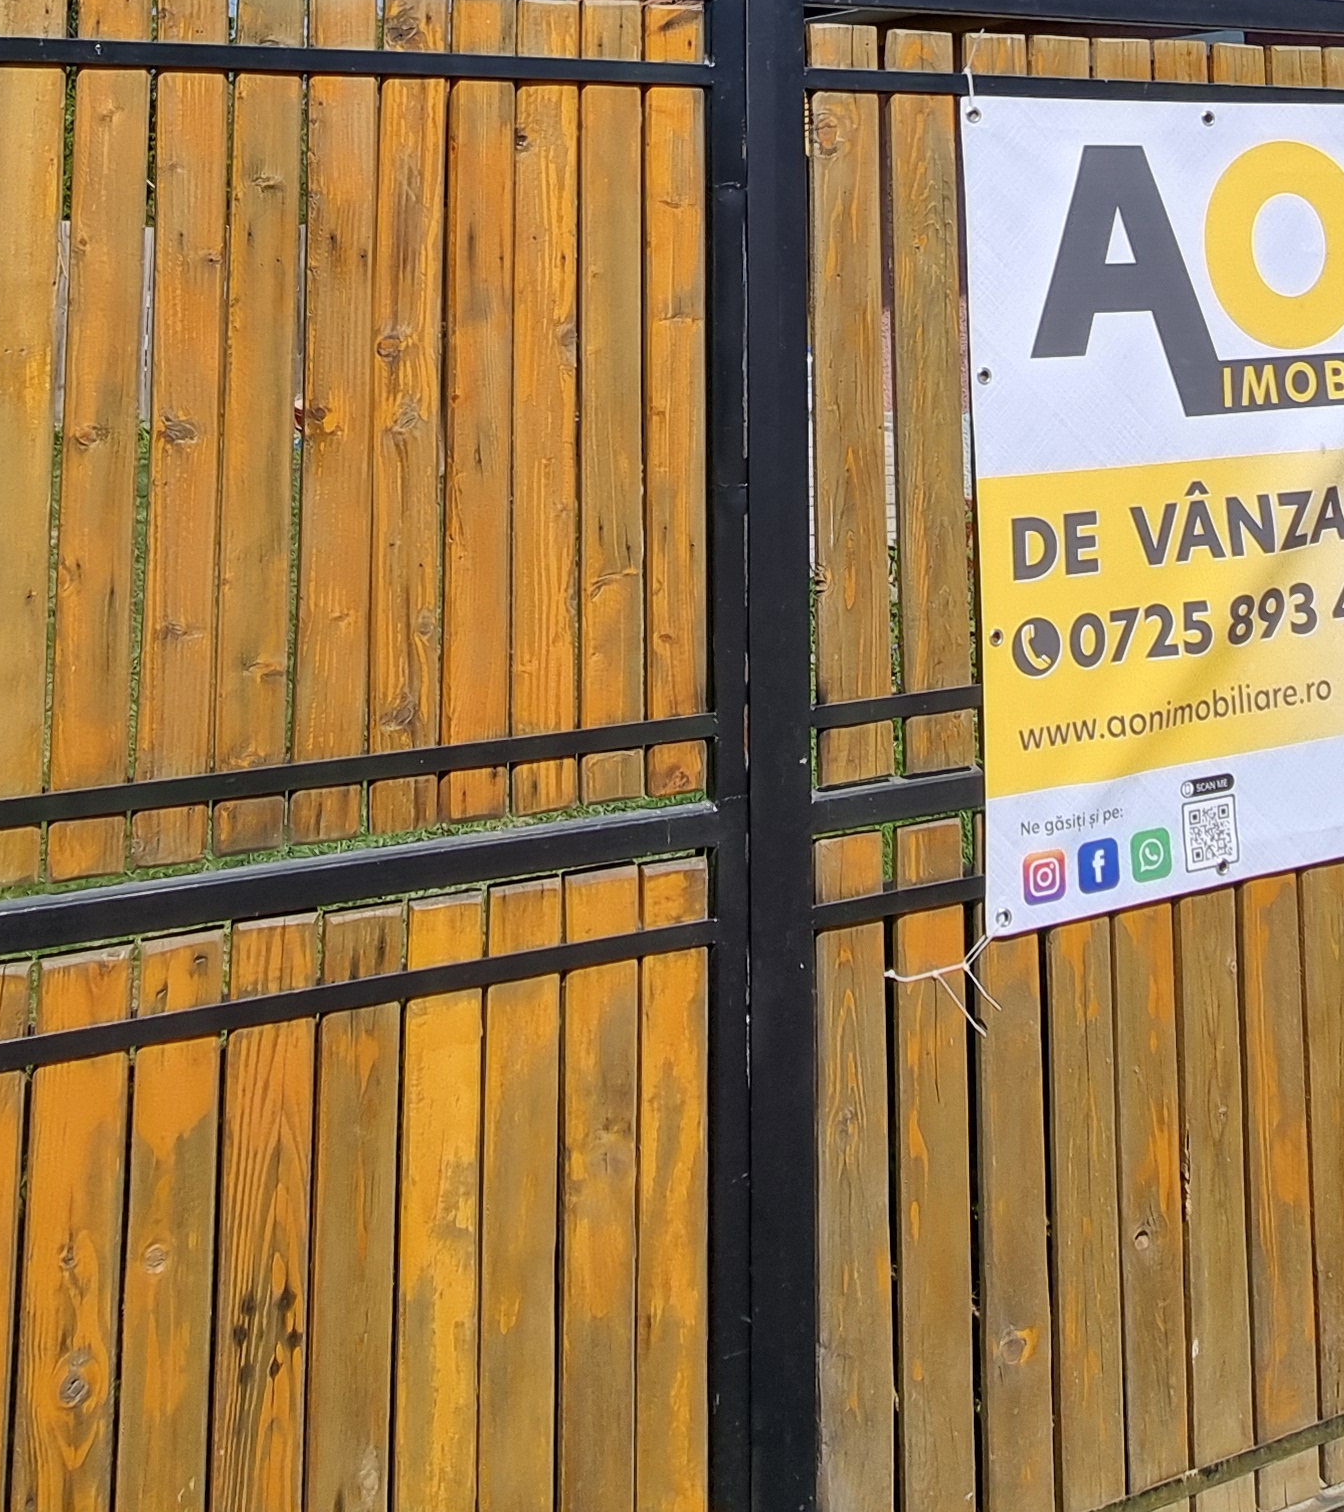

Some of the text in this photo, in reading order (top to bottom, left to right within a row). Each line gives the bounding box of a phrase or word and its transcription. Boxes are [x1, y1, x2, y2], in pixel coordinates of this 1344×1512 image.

[1011, 510, 1100, 582] DE
[1069, 599, 1214, 669] 0725
[1227, 582, 1318, 646] 893
[1018, 679, 1333, 752] www.aonimobiliare.ro
[1020, 806, 1124, 836] Ne găsiți și pe:
[1196, 778, 1228, 792] SCAN ME
